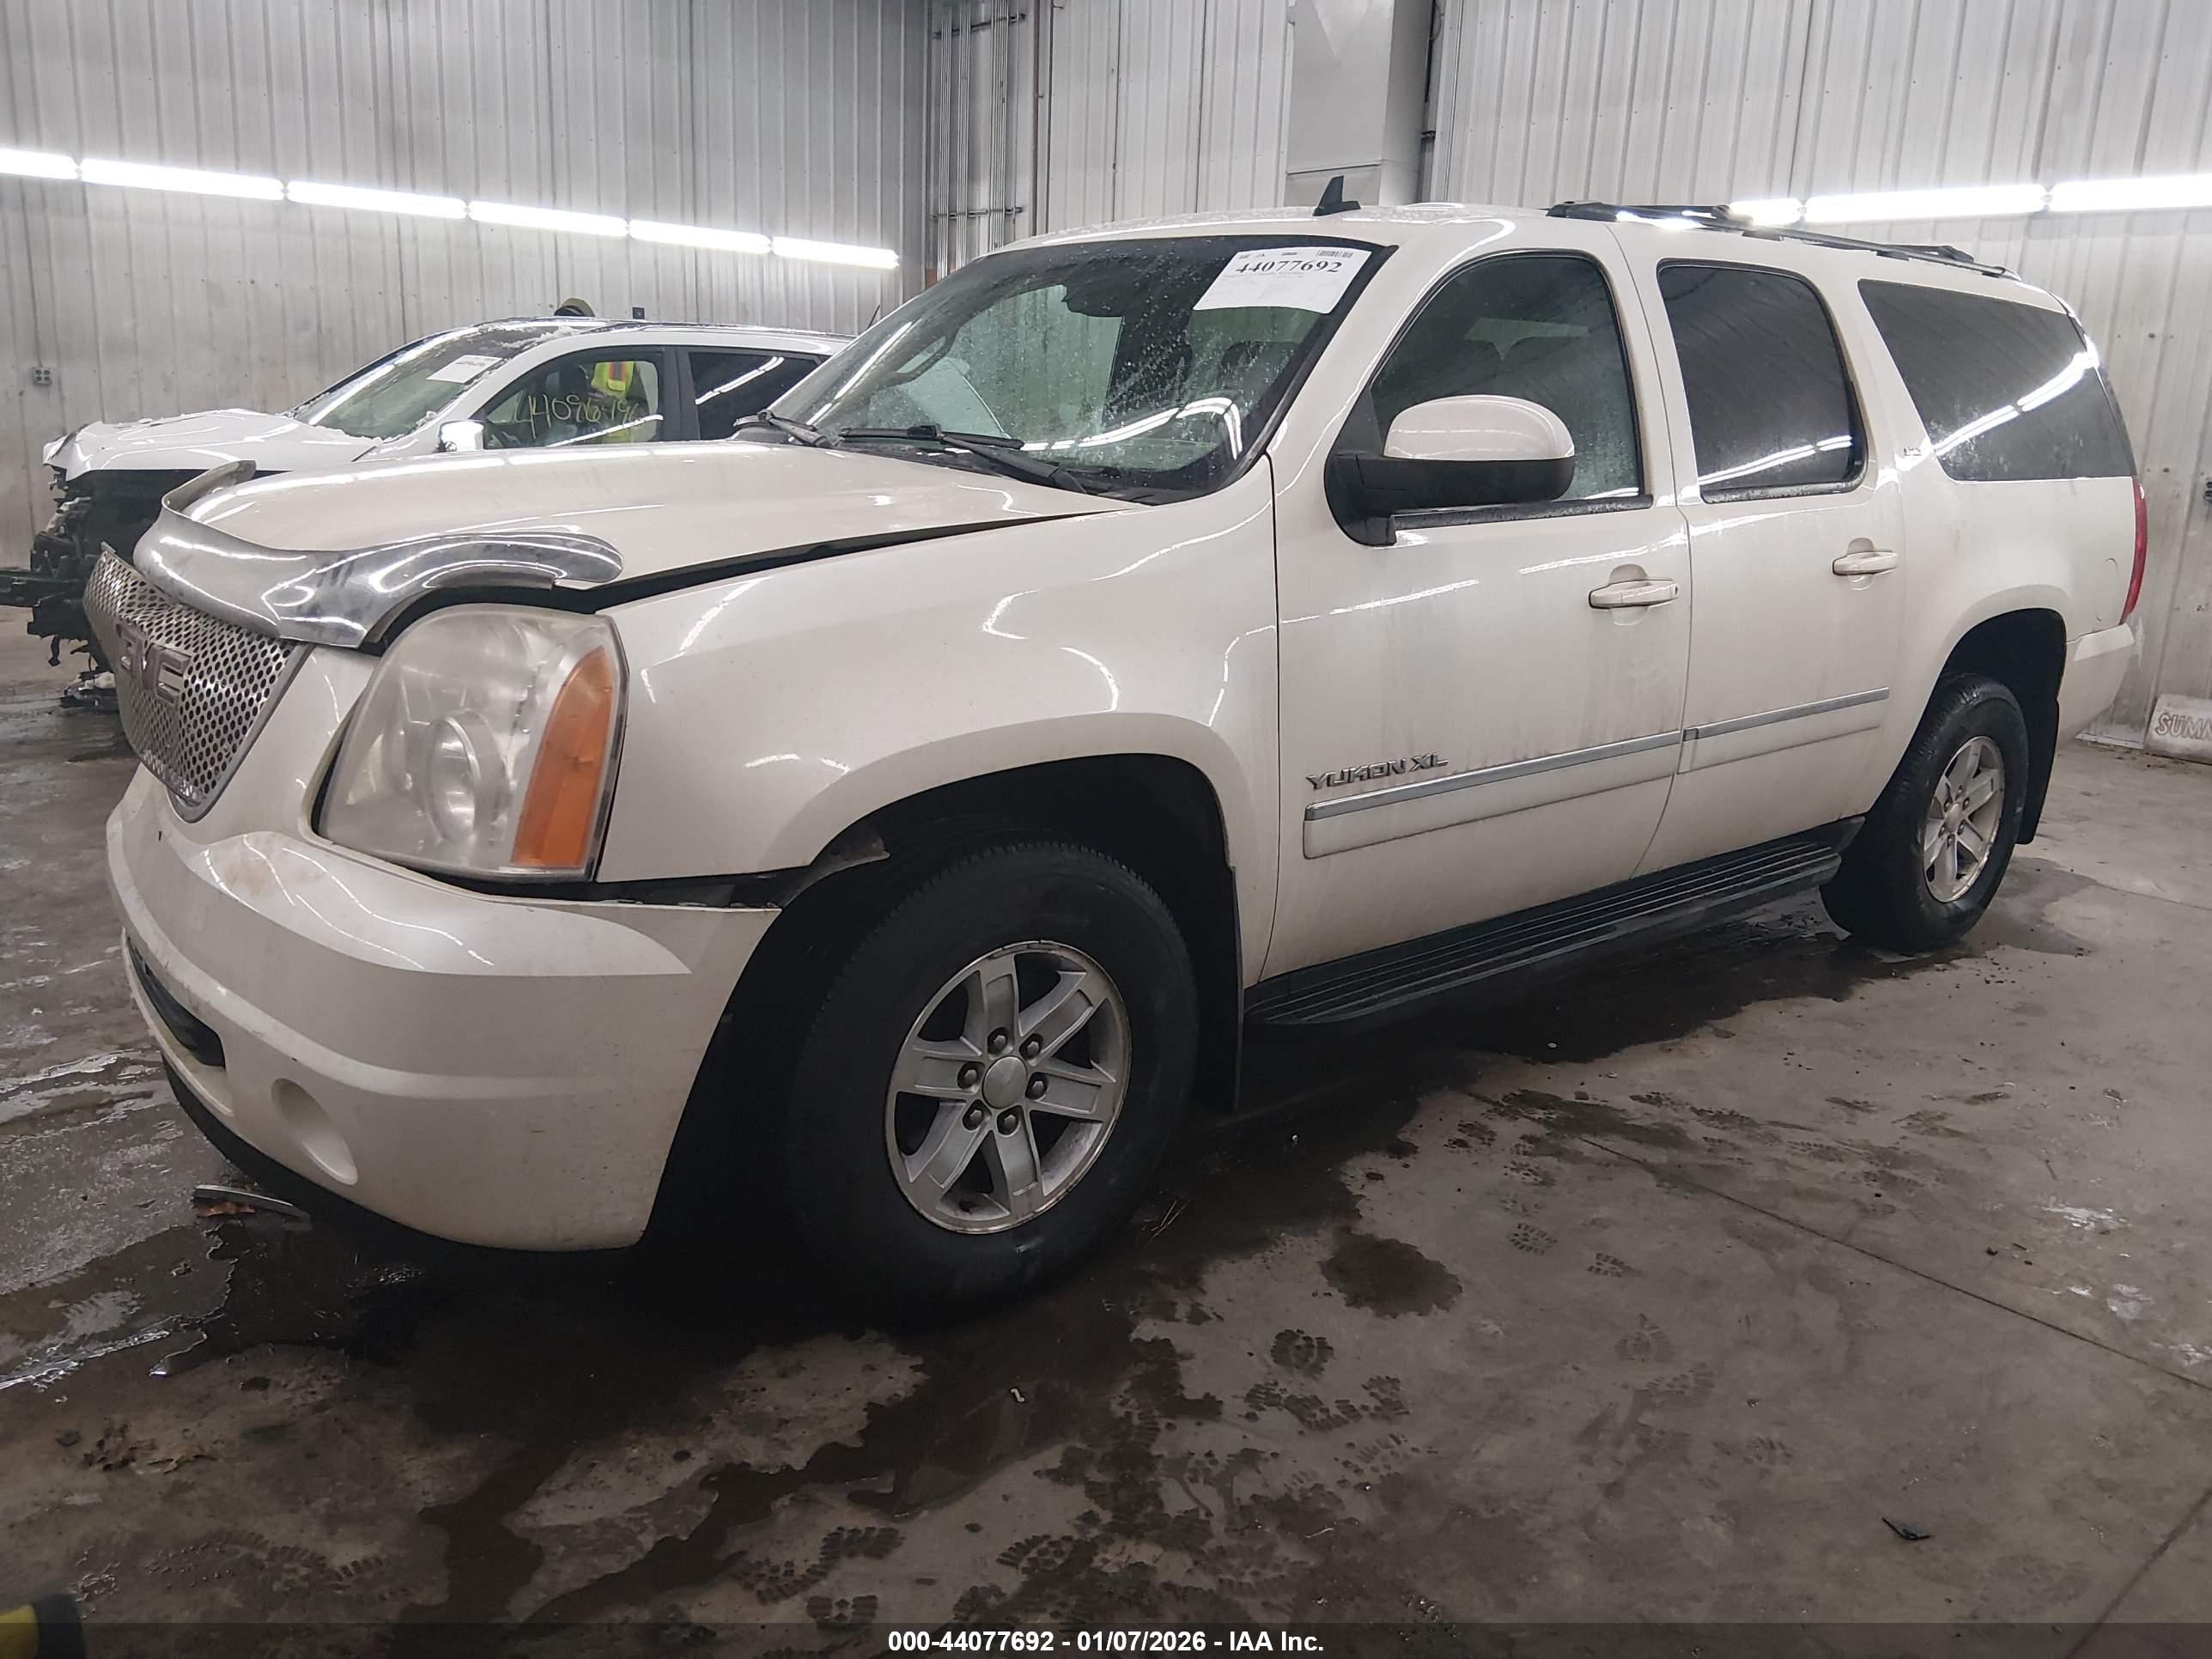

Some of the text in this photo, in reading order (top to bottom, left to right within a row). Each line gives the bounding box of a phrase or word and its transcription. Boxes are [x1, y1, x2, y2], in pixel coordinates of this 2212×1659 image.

[1236, 259, 1342, 274] 44077692
[1306, 752, 1449, 791] YUKON XL
